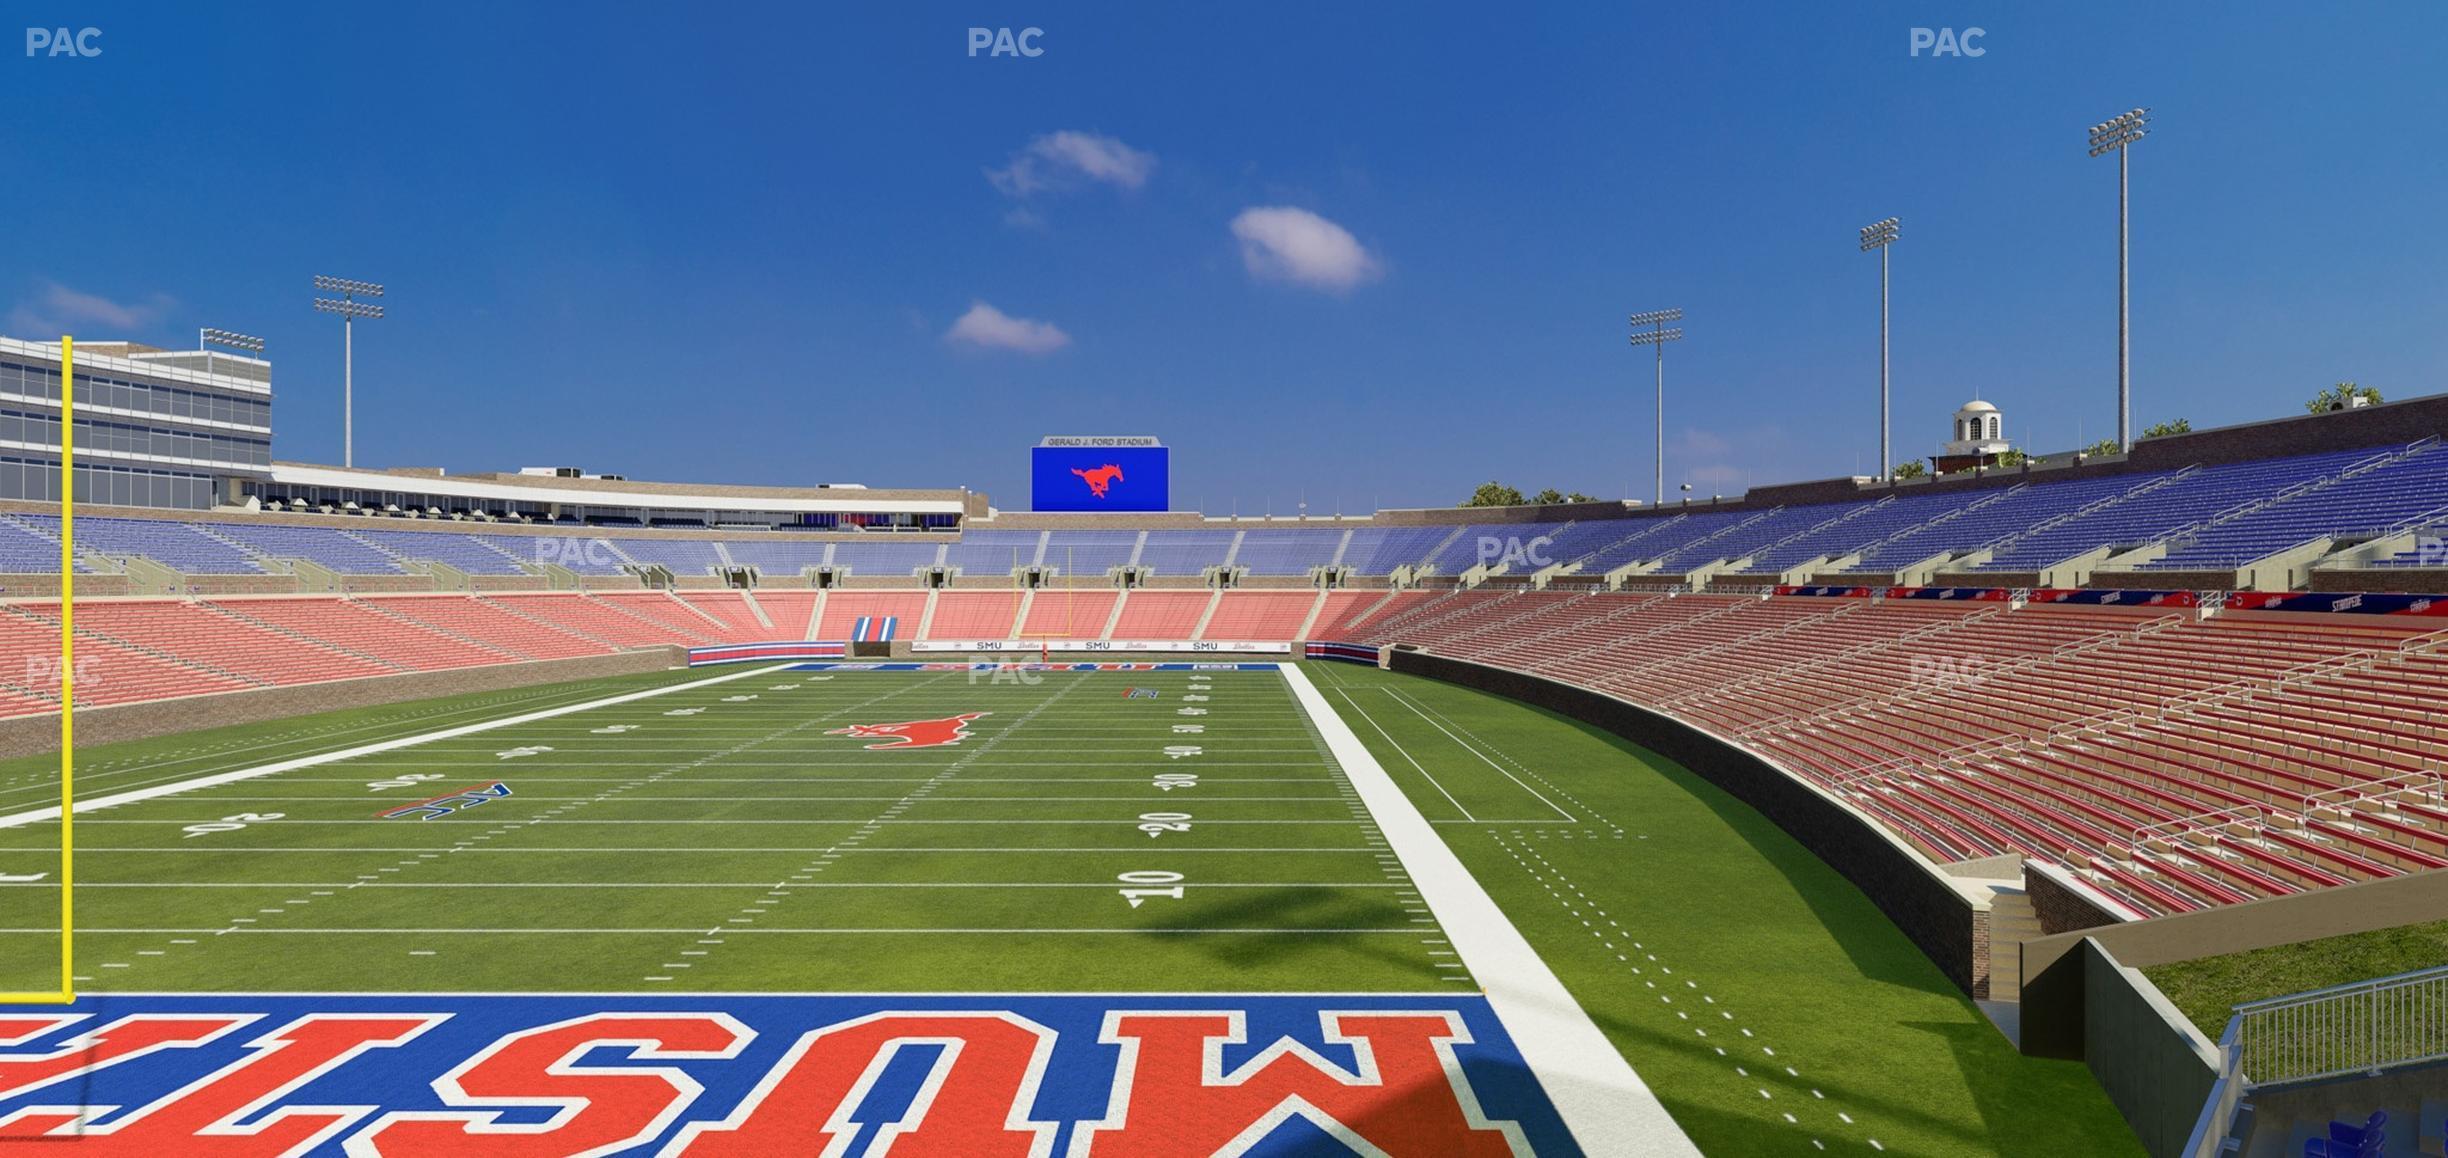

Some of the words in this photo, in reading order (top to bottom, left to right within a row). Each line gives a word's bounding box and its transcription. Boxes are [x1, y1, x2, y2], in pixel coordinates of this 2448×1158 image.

[1048, 438, 1081, 446] GERALD
[1092, 438, 1115, 446] FORD
[1117, 438, 1153, 446] STADIUM
[977, 642, 1002, 650] SMU
[1086, 642, 1111, 650] SMU
[1193, 642, 1218, 650] SMU
[182, 812, 286, 832] 20
[1138, 812, 1192, 831] 20
[1117, 871, 1184, 898] 10
